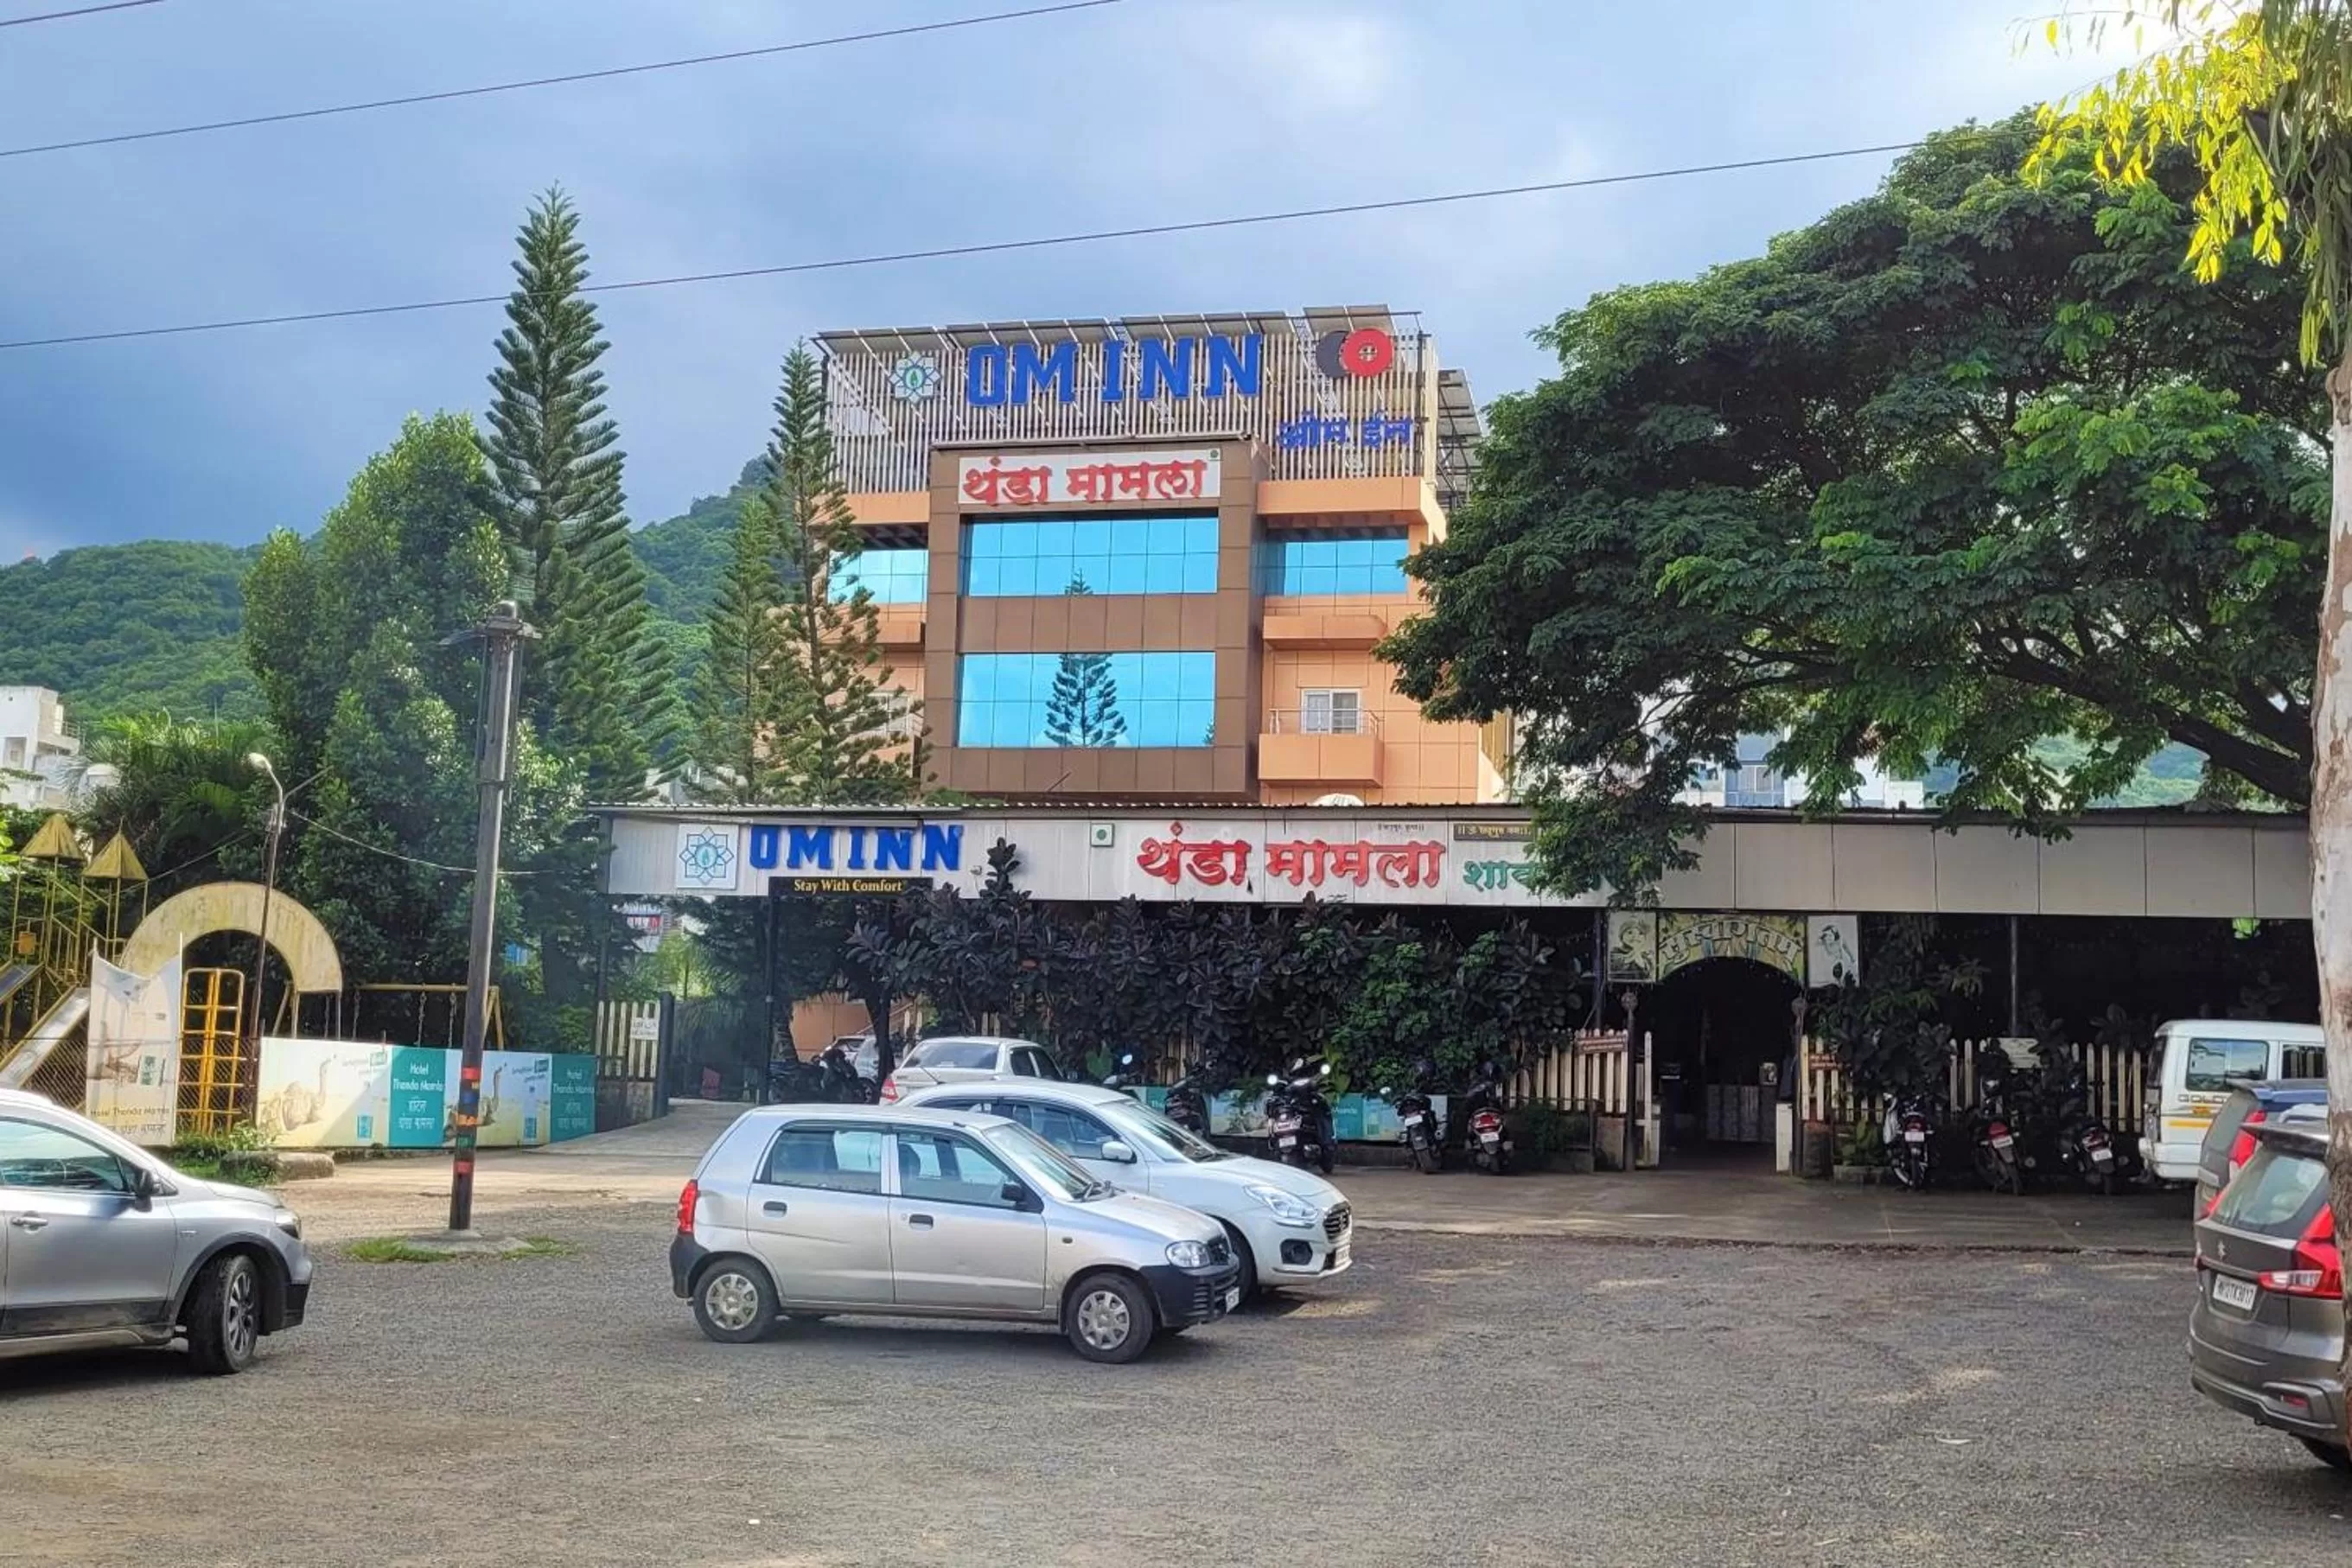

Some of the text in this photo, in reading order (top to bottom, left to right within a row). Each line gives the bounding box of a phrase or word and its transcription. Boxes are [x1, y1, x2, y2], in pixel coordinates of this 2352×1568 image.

[967, 334, 1263, 406] OM INN
[963, 456, 1208, 507] थंडा मामला
[749, 824, 964, 871] OM INN
[1137, 820, 1252, 887] थंडा
[1264, 838, 1447, 889] मामला
[794, 878, 902, 894] Stay With Comfort
[409, 1061, 430, 1075] Hotel
